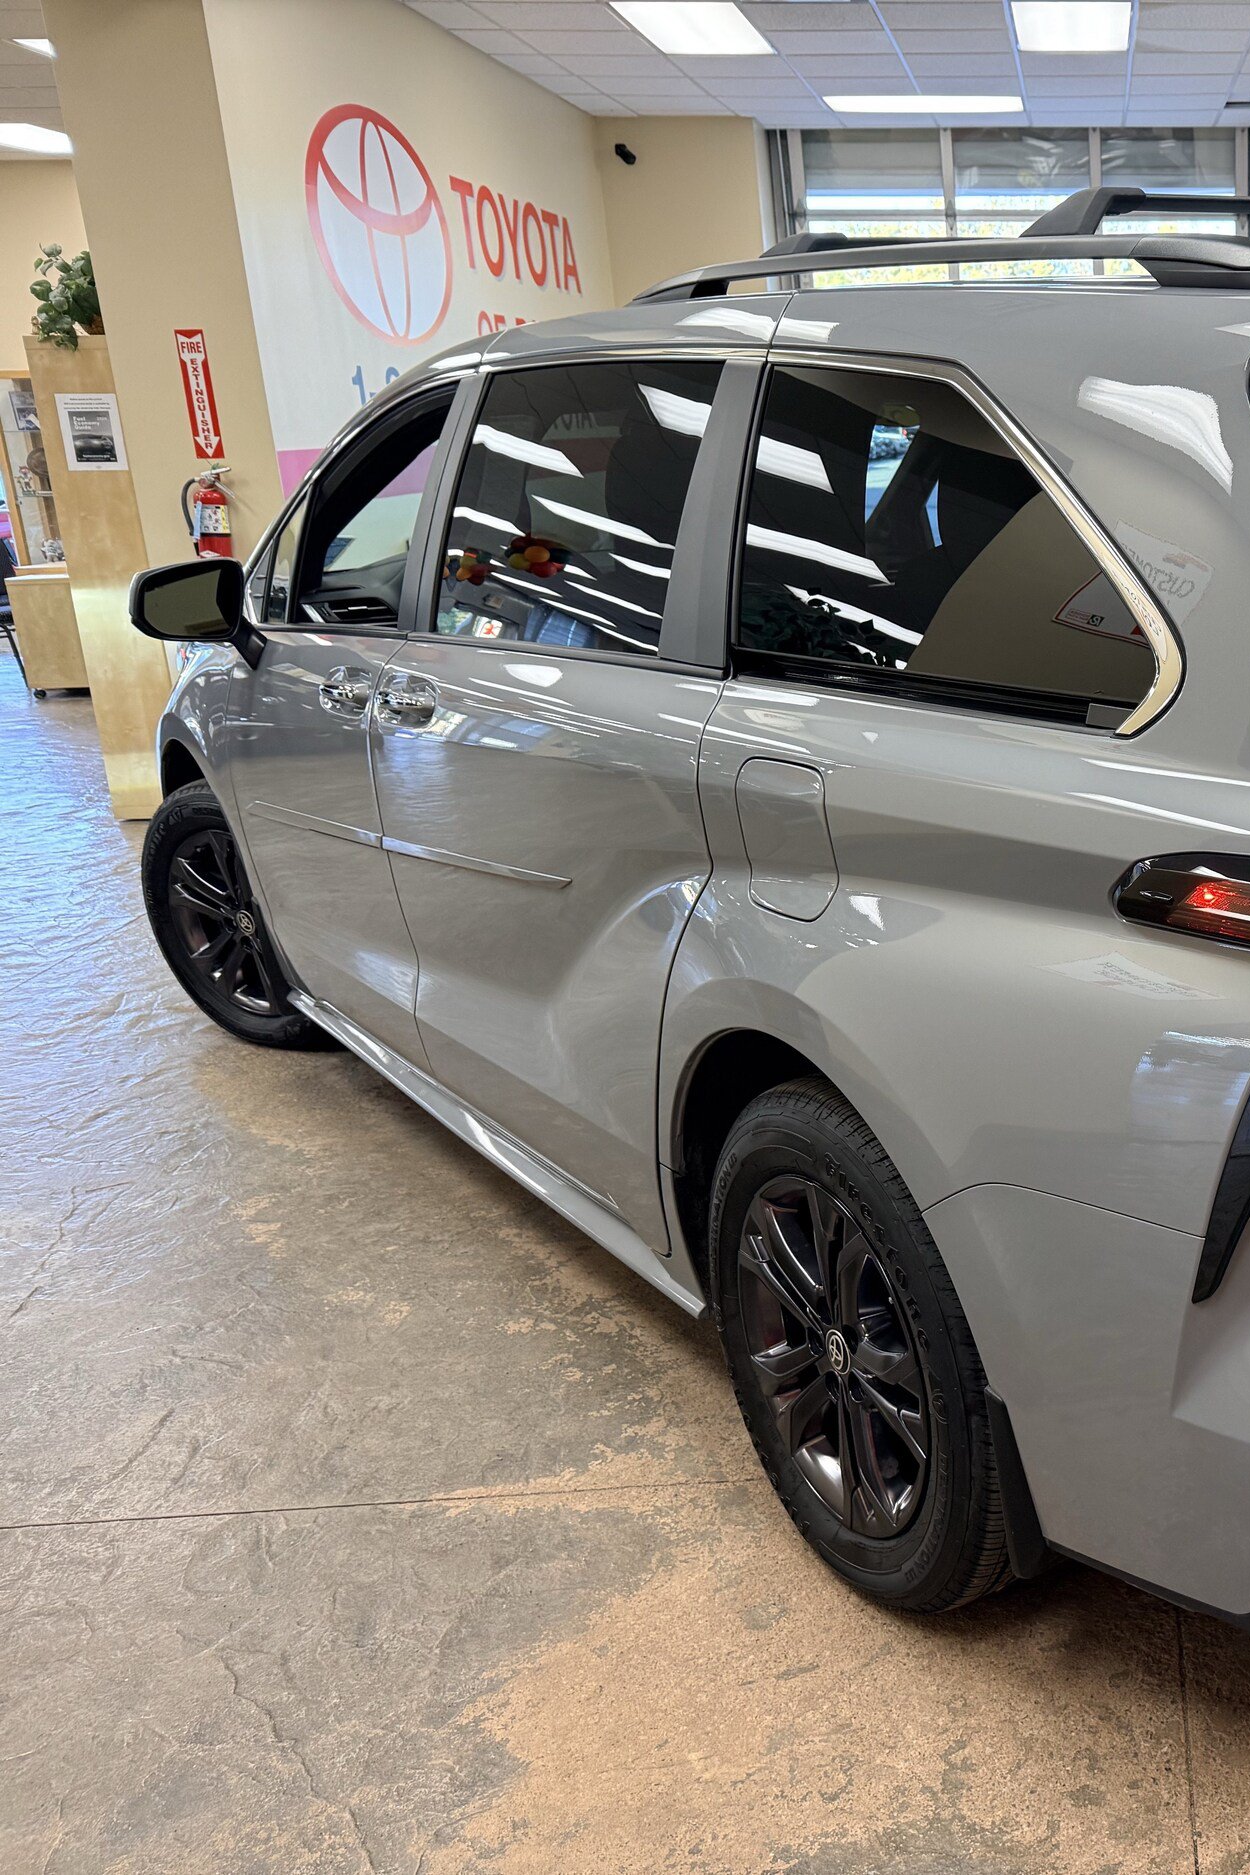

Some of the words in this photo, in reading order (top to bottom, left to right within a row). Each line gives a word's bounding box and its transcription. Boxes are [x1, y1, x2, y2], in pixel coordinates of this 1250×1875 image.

[449, 175, 582, 294] TOYOTA
[180, 341, 202, 354] FIRE
[190, 358, 213, 449] EXTINGUISHER
